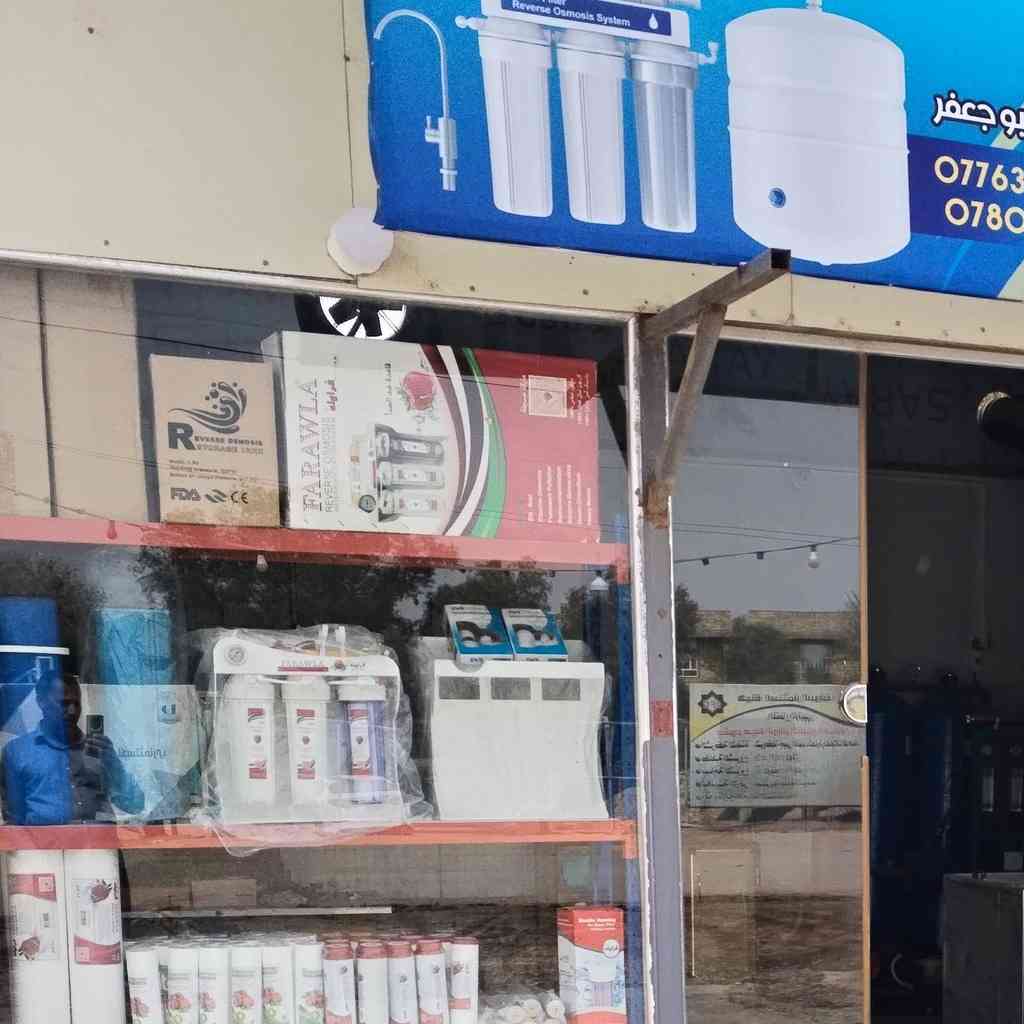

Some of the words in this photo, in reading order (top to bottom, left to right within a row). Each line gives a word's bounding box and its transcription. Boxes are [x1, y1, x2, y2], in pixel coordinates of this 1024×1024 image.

[512, 0, 551, 14] Reverse
[553, 9, 594, 21] Osmosis
[596, 14, 631, 27] System
[932, 91, 997, 133] جعفر
